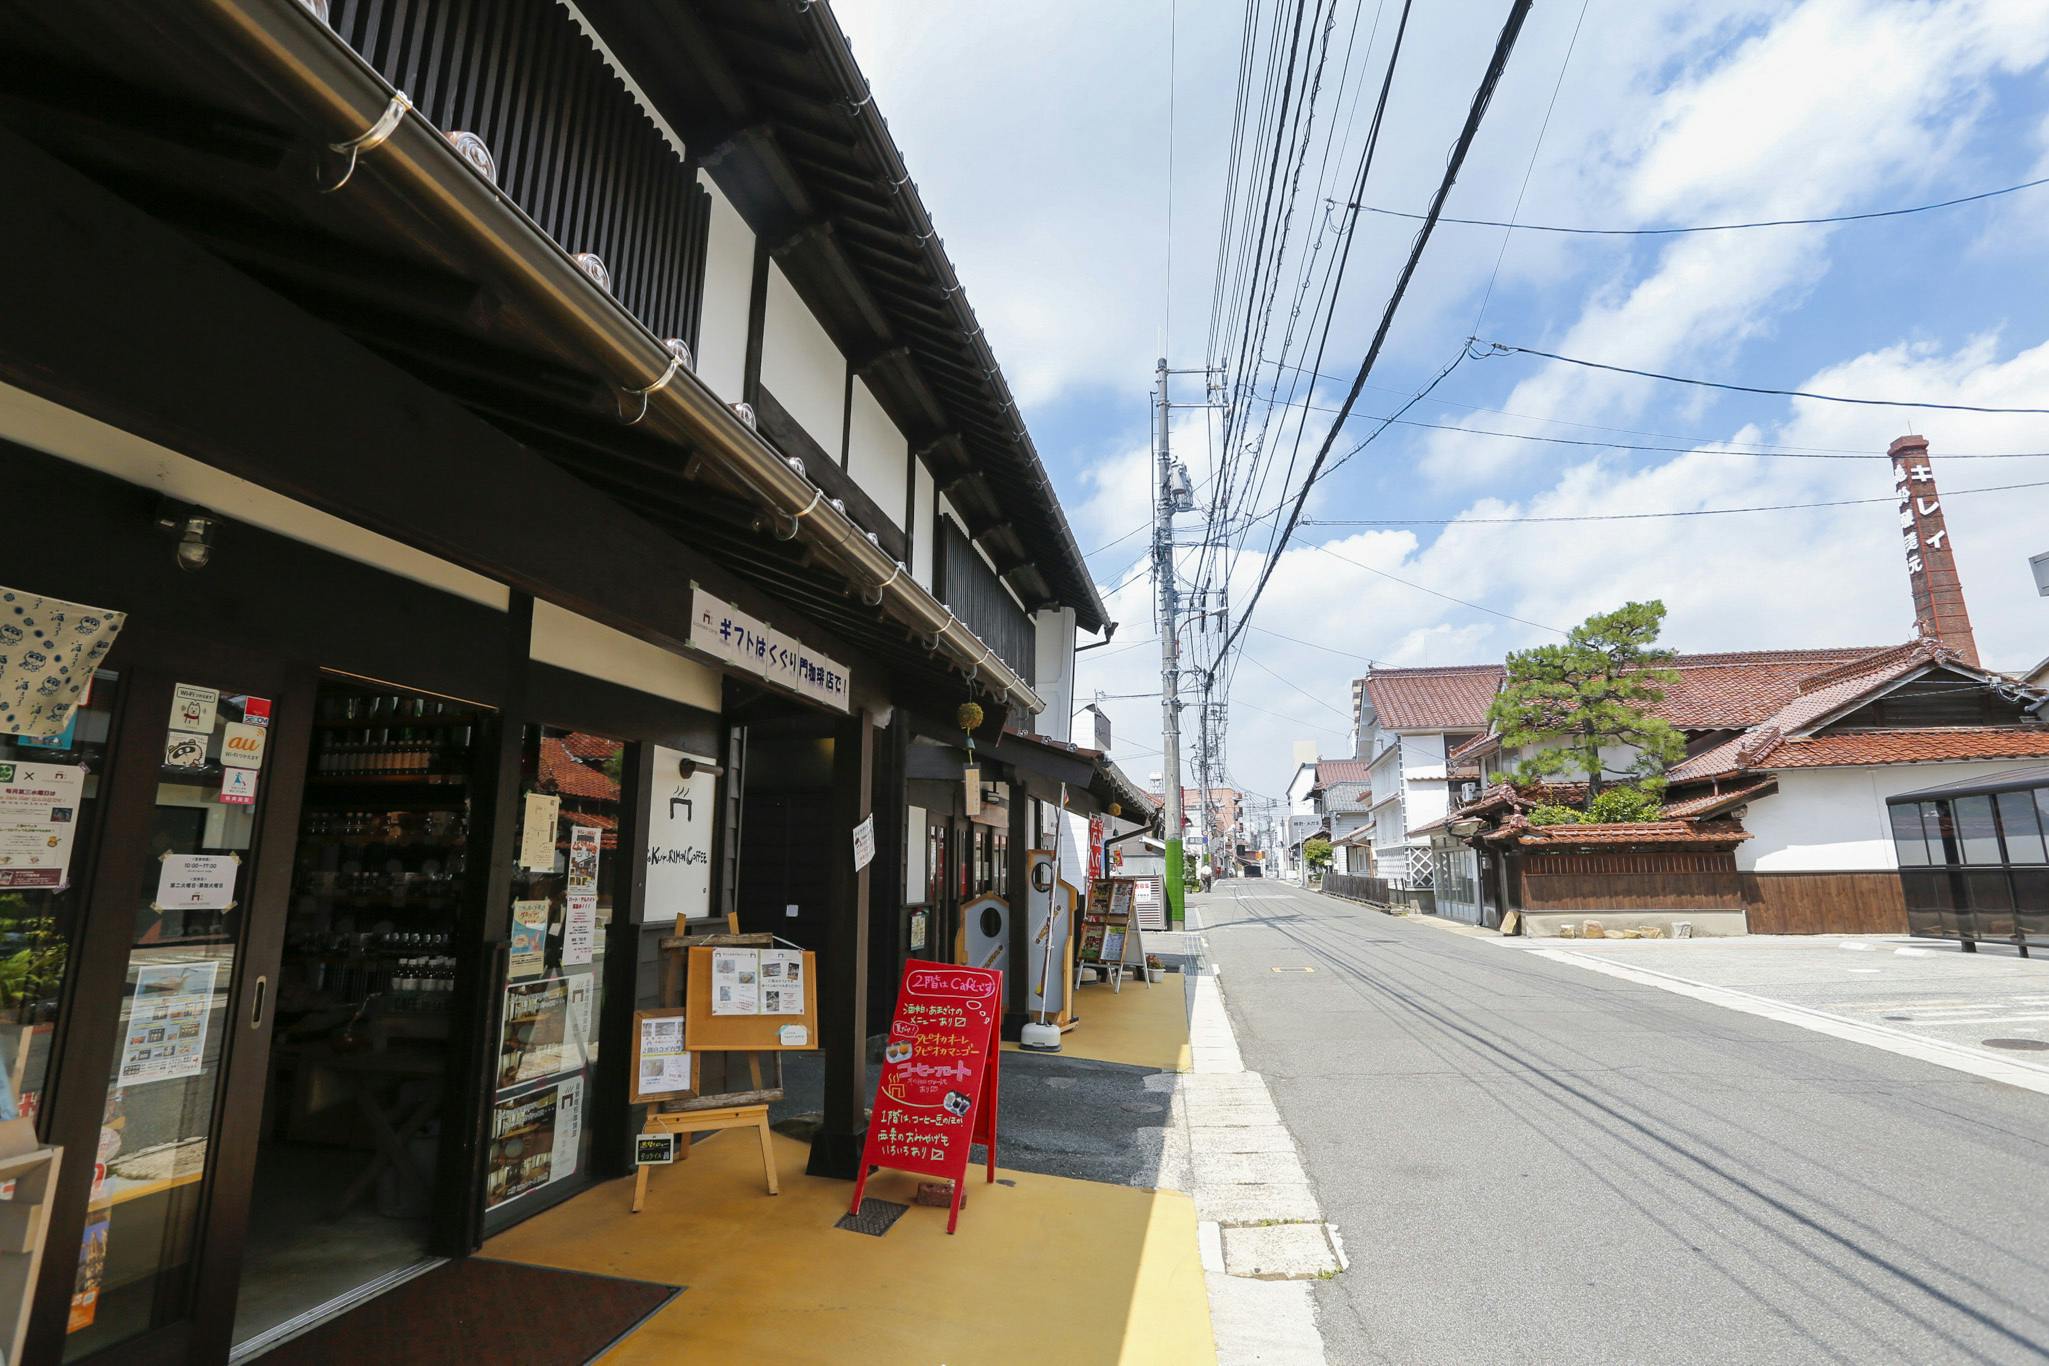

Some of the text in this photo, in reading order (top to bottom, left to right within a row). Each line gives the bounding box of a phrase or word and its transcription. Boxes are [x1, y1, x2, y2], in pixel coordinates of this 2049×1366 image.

[1910, 464, 1946, 549] キレイ
[228, 736, 259, 751] au
